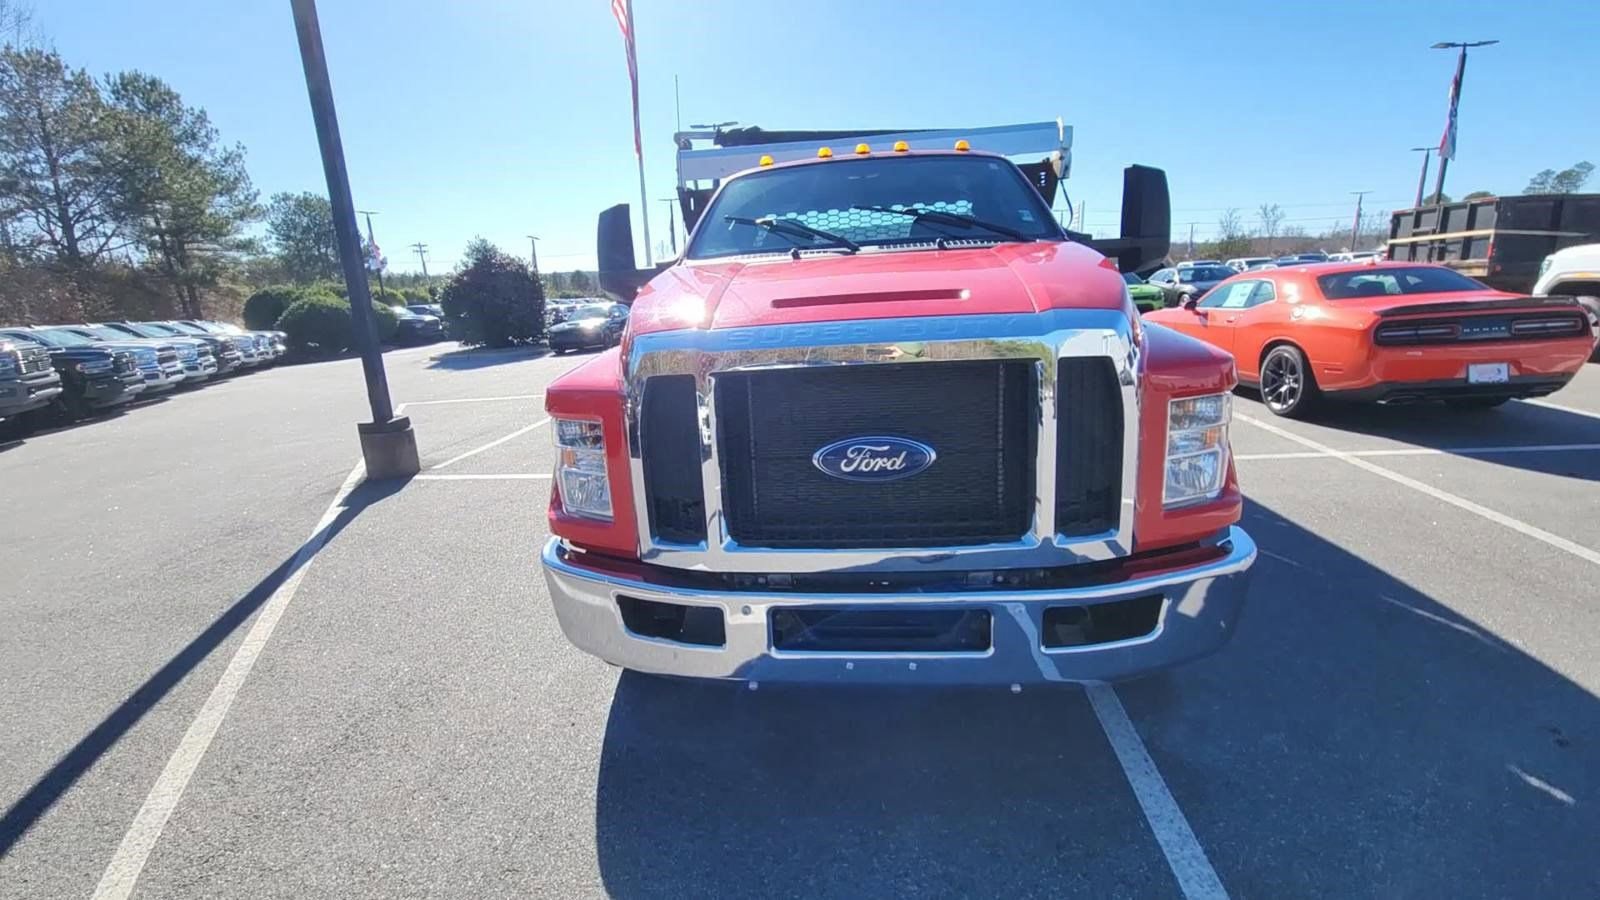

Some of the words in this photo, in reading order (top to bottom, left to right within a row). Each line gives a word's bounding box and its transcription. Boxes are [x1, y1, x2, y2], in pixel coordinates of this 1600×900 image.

[727, 325, 875, 345] SUPER
[901, 318, 1018, 338] DUTY
[840, 444, 907, 473] Ford
